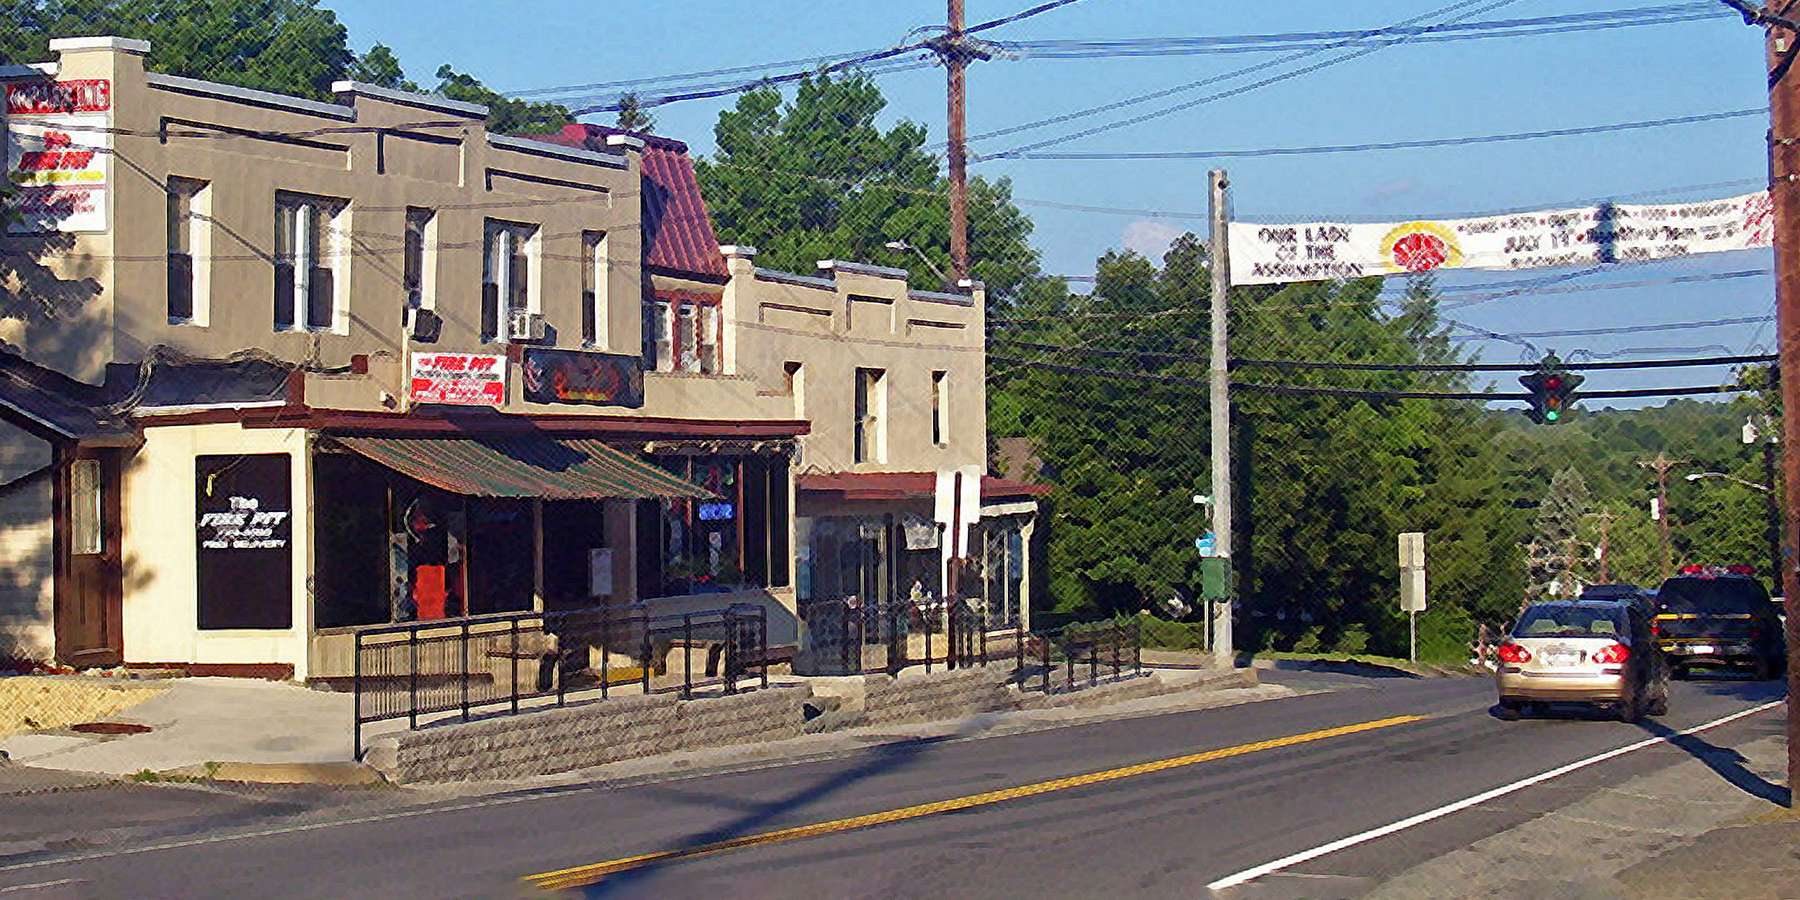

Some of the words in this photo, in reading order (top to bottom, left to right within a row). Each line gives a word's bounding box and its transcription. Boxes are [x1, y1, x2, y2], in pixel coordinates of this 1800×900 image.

[1258, 226, 1298, 244] OUR
[1304, 226, 1350, 244] LADY
[1304, 243, 1337, 261] THE
[1252, 260, 1364, 278] ASSUMPTION
[432, 355, 468, 371] FIRE
[467, 356, 498, 371] PIT
[229, 496, 259, 510] The
[200, 511, 249, 527] FIRE
[250, 510, 289, 527] PIT
